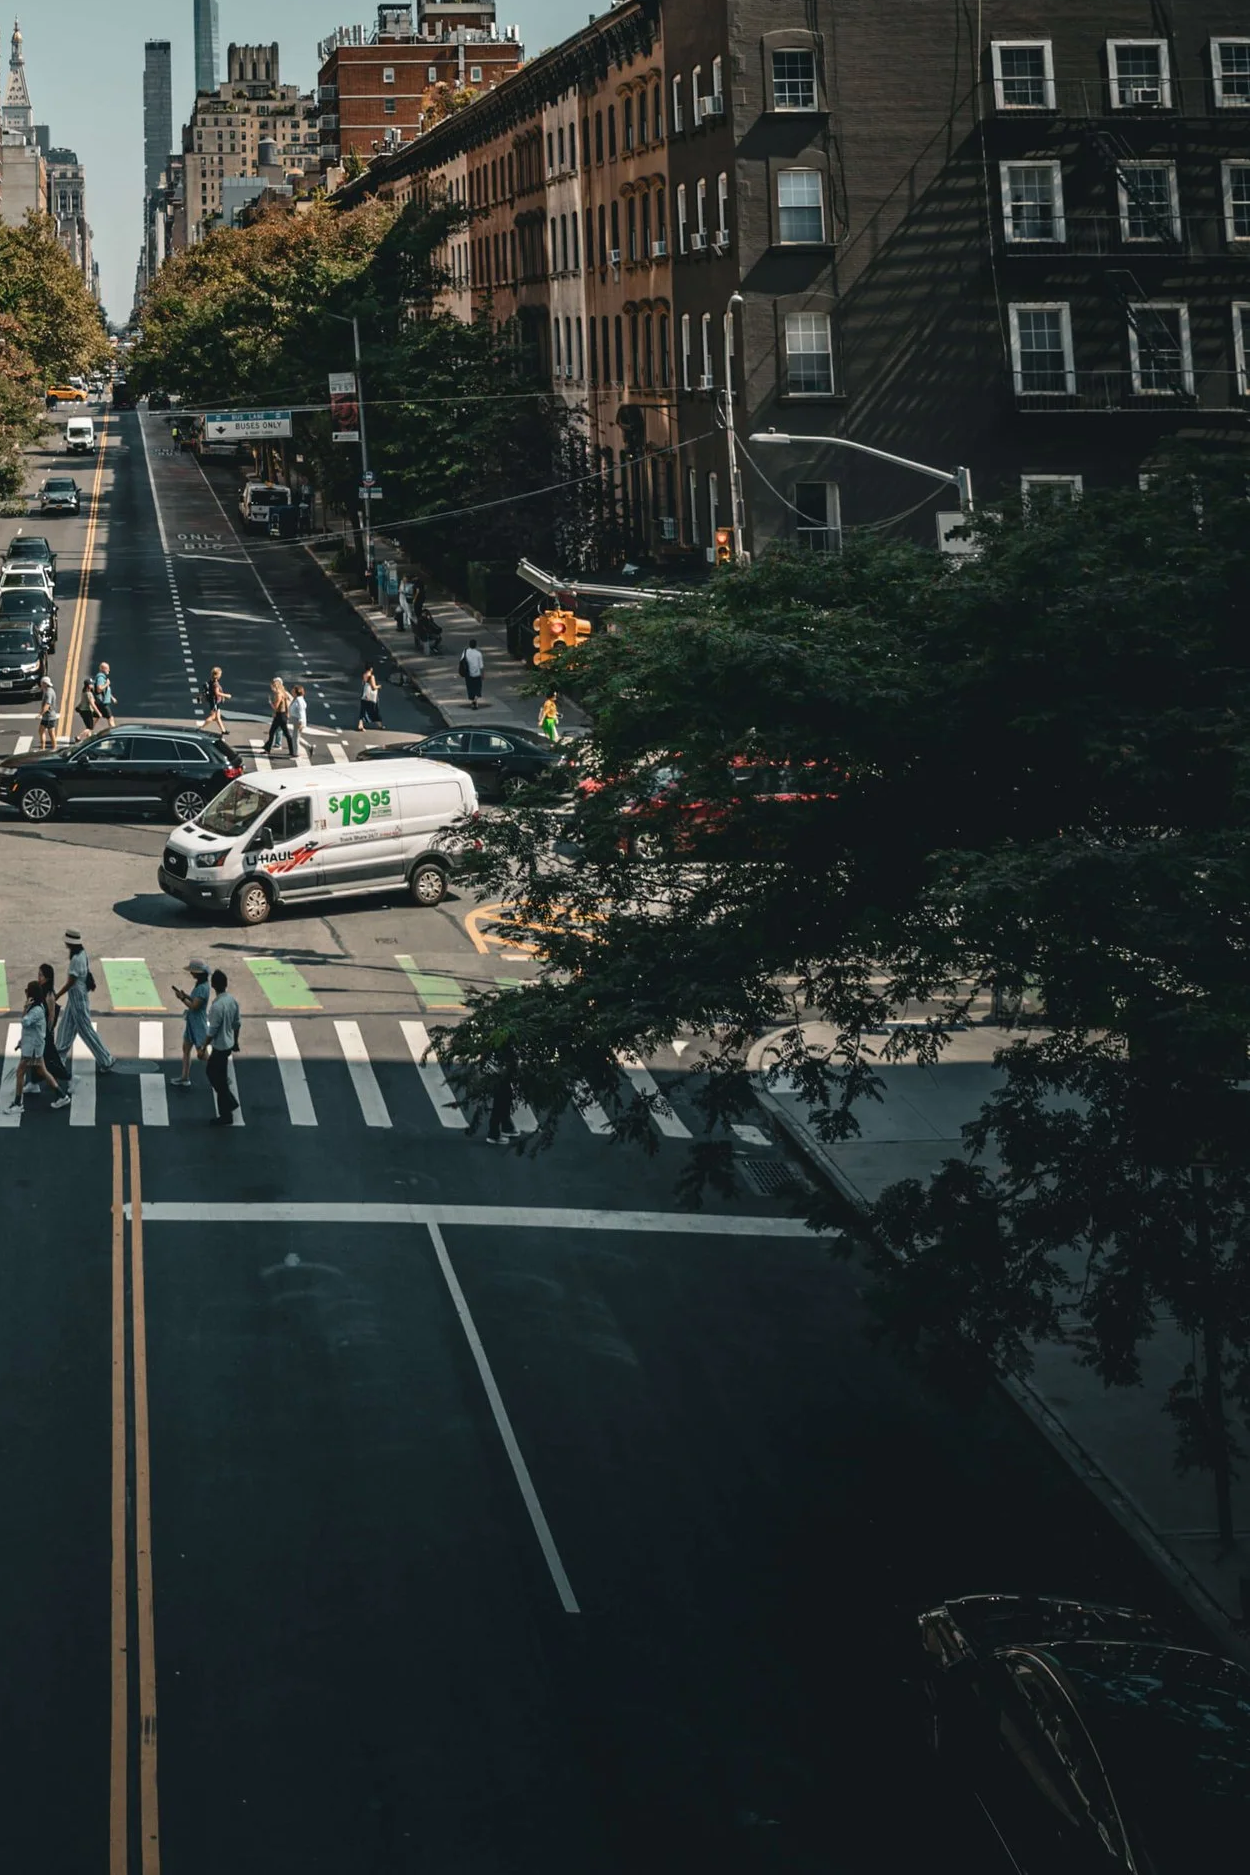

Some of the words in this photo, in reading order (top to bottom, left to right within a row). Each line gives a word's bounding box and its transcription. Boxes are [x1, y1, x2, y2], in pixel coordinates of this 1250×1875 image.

[235, 422, 260, 430] BUSES
[262, 421, 282, 429] ONLY
[177, 533, 222, 541] ONLY
[246, 850, 294, 866] U-HAUL
